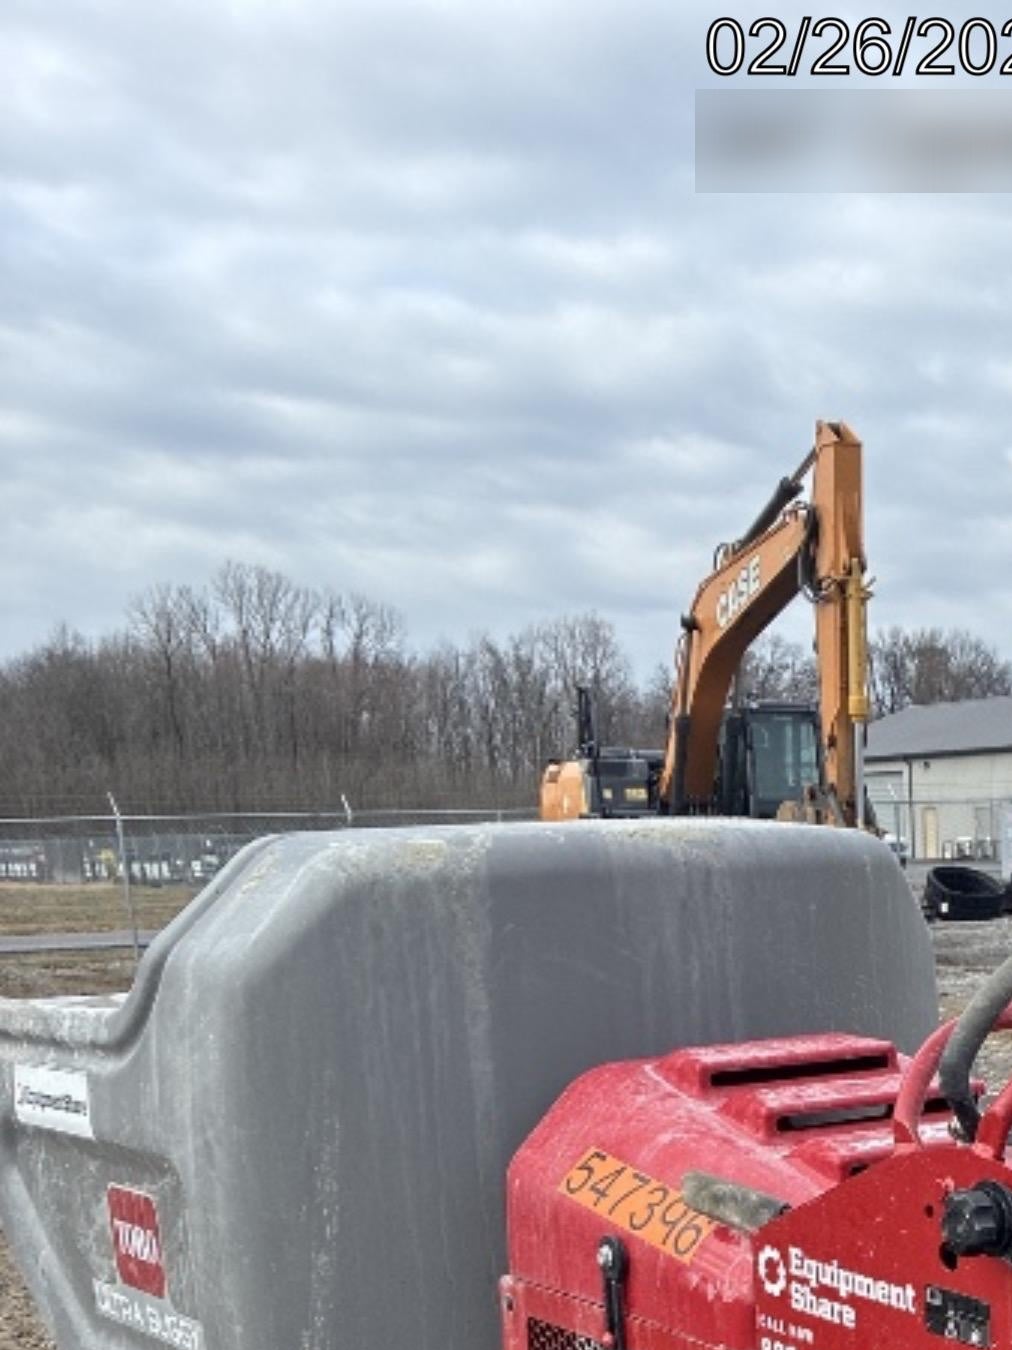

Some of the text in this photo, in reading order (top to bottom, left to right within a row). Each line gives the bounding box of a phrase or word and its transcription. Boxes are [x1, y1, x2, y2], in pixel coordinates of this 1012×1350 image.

[716, 554, 760, 628] CASE
[566, 1151, 703, 1256] 547396
[788, 1246, 917, 1315] Equipment
[790, 1281, 857, 1330] Share
